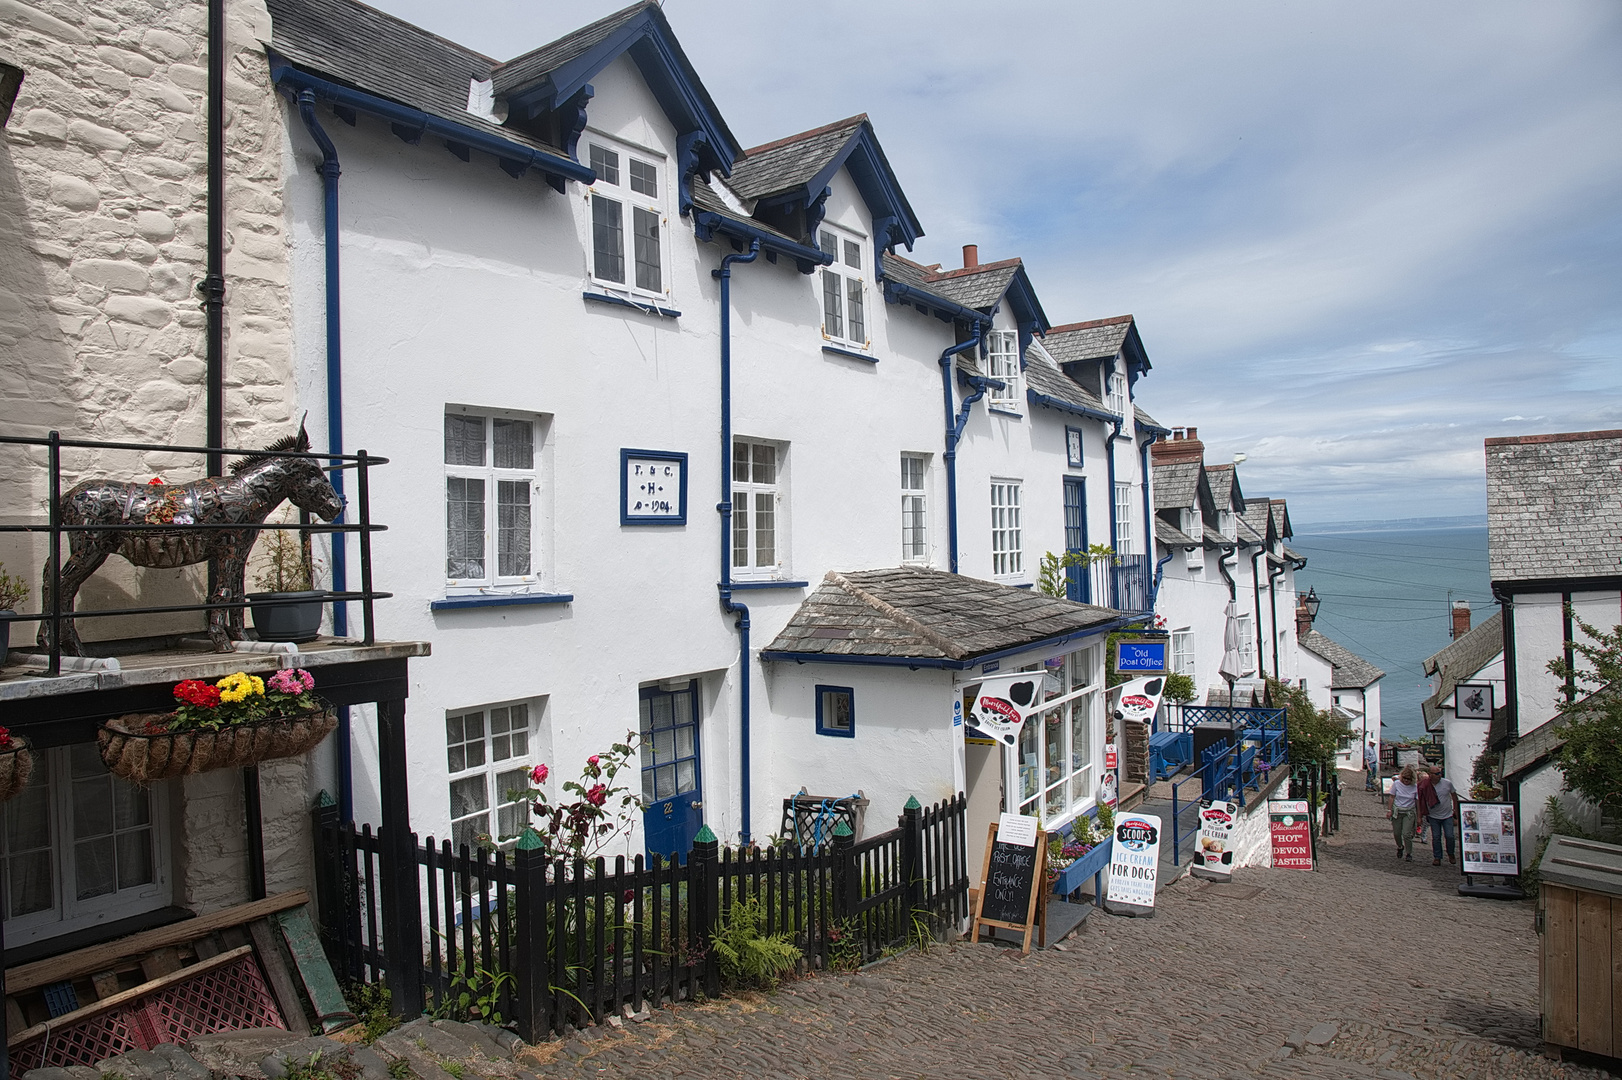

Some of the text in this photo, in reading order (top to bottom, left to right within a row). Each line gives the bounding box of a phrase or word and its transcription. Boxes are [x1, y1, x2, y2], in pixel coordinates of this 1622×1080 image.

[648, 482, 655, 494] H
[1134, 649, 1149, 658] Old
[983, 661, 999, 671] Entrance
[1120, 657, 1163, 667] Post Office
[664, 802, 673, 815] 22
[1202, 829, 1229, 840] ICE CREAM
[1273, 834, 1303, 842] "HOT"
[1273, 846, 1307, 854] DEVON
[1116, 852, 1153, 866] ICE CREAM
[1272, 857, 1312, 866] PASTIES
[1112, 863, 1155, 881] FOR DOGS
